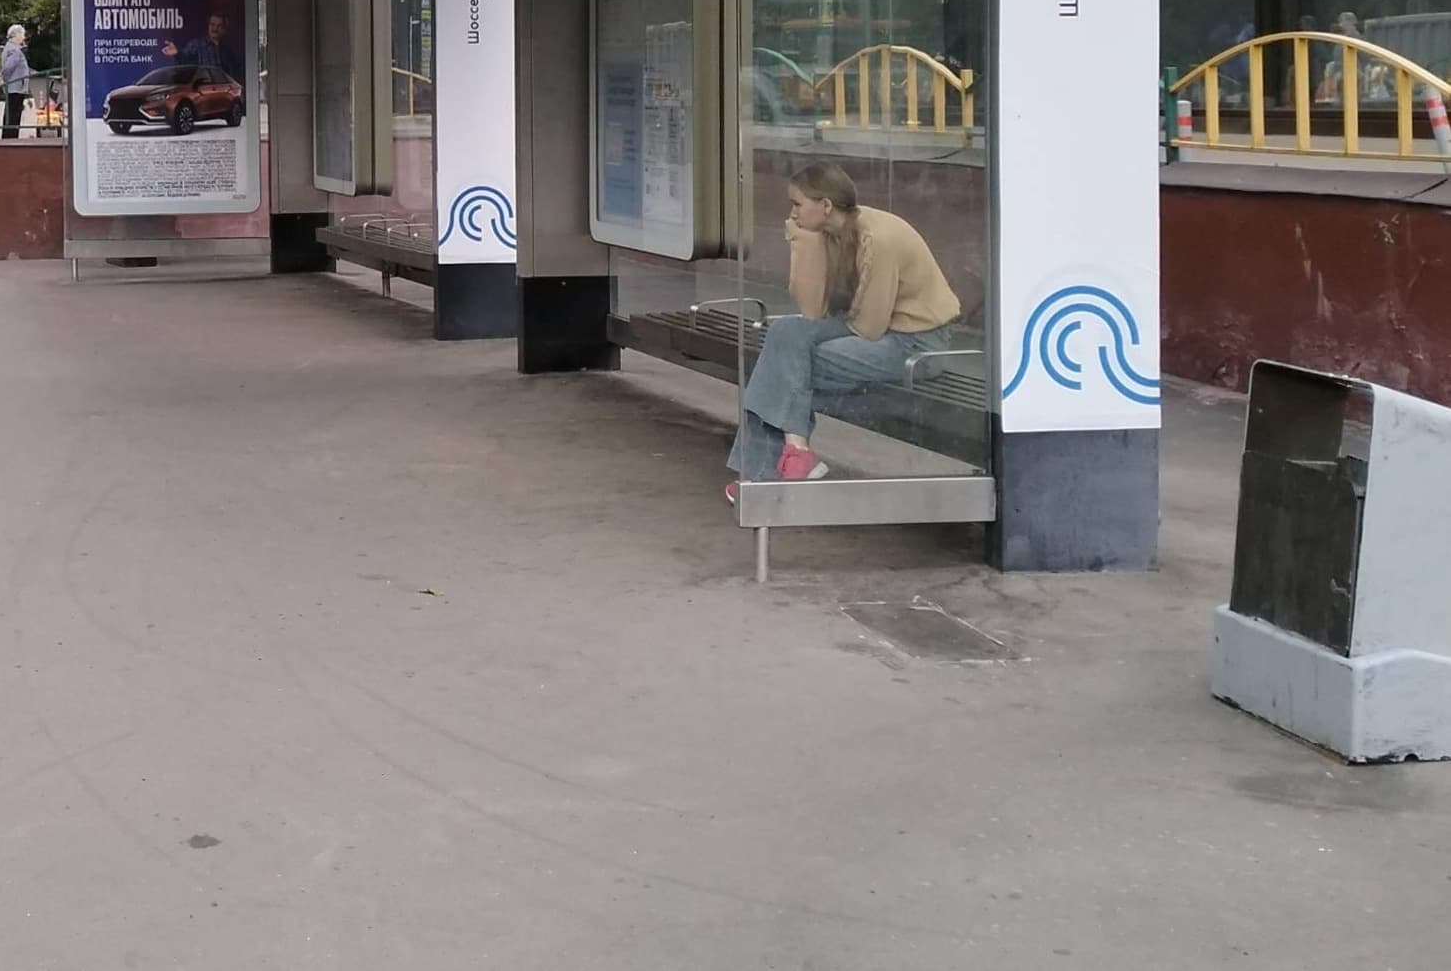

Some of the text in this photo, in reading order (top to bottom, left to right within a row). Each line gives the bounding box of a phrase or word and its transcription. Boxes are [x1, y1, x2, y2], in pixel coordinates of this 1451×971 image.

[94, 8, 184, 30] АВТОМОБИЛЬ
[94, 39, 158, 47] ПРИ ПЕРЕВОДЕ
[94, 47, 130, 55] ПЕНСИИ
[131, 55, 153, 63] БАНК
